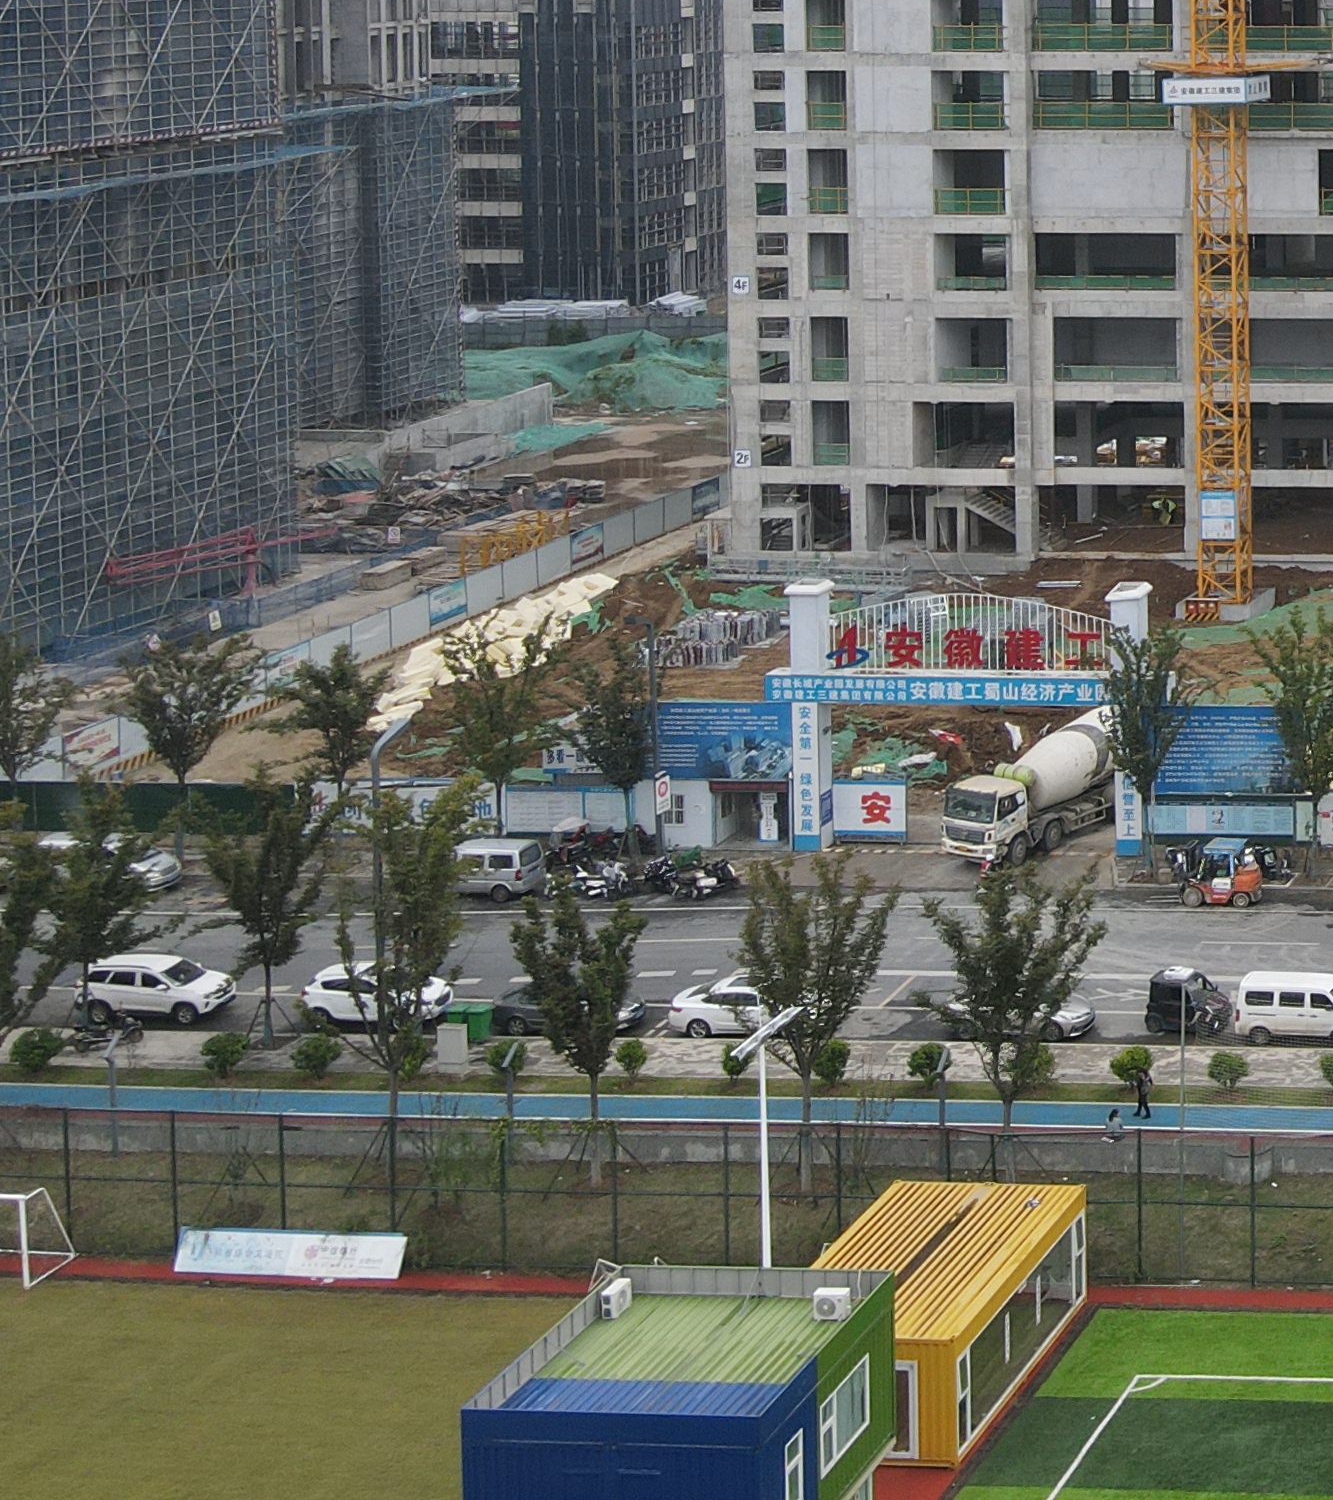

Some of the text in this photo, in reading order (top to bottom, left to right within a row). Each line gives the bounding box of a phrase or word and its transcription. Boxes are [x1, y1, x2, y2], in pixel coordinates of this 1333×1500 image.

[884, 625, 1103, 669] 安徽建工
[798, 706, 814, 833] 安全第一 绿色发展
[860, 791, 892, 825] 安
